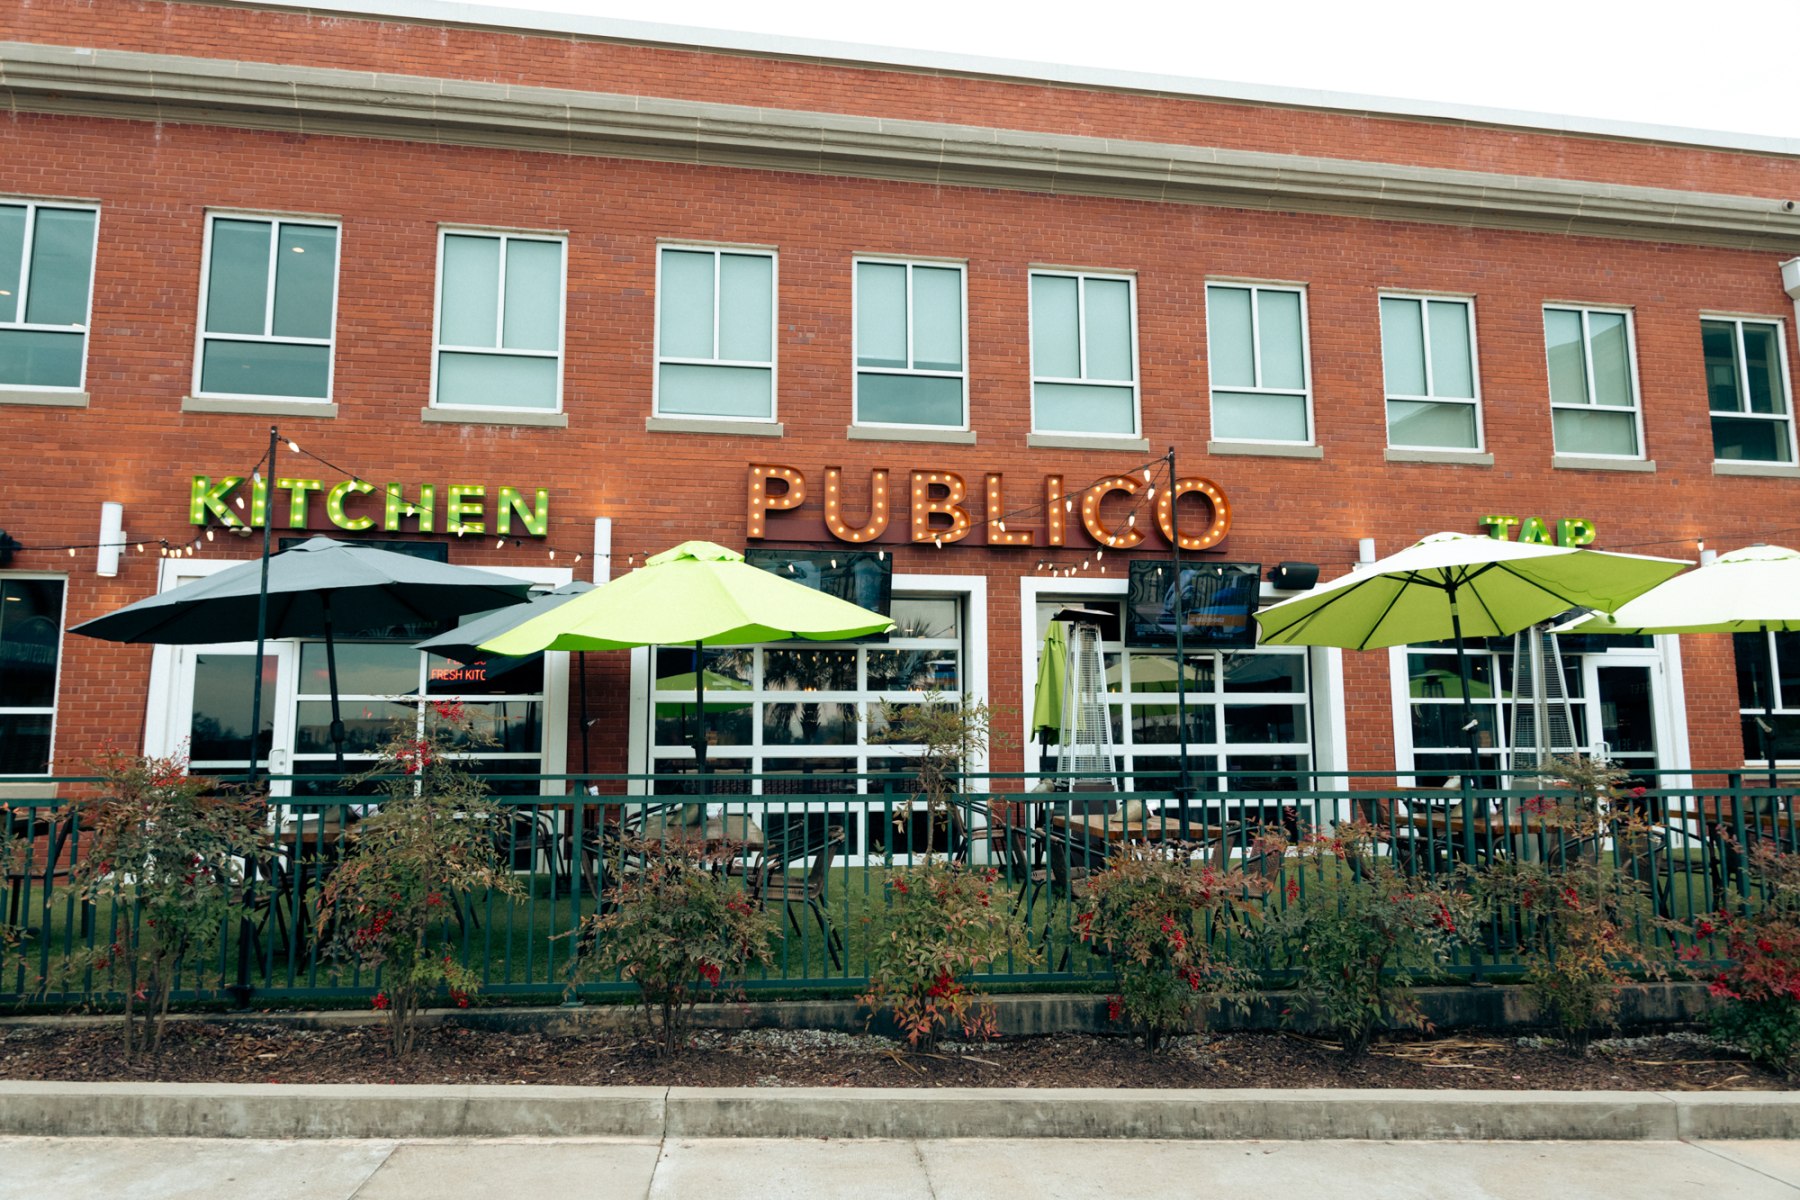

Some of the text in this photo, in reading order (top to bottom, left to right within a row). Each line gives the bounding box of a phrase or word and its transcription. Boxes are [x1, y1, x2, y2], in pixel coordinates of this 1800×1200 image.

[190, 475, 549, 536] KITCHEN
[747, 463, 1232, 550] PUBLICO
[1479, 515, 1596, 548] TAP
[431, 669, 462, 680] FRESH
